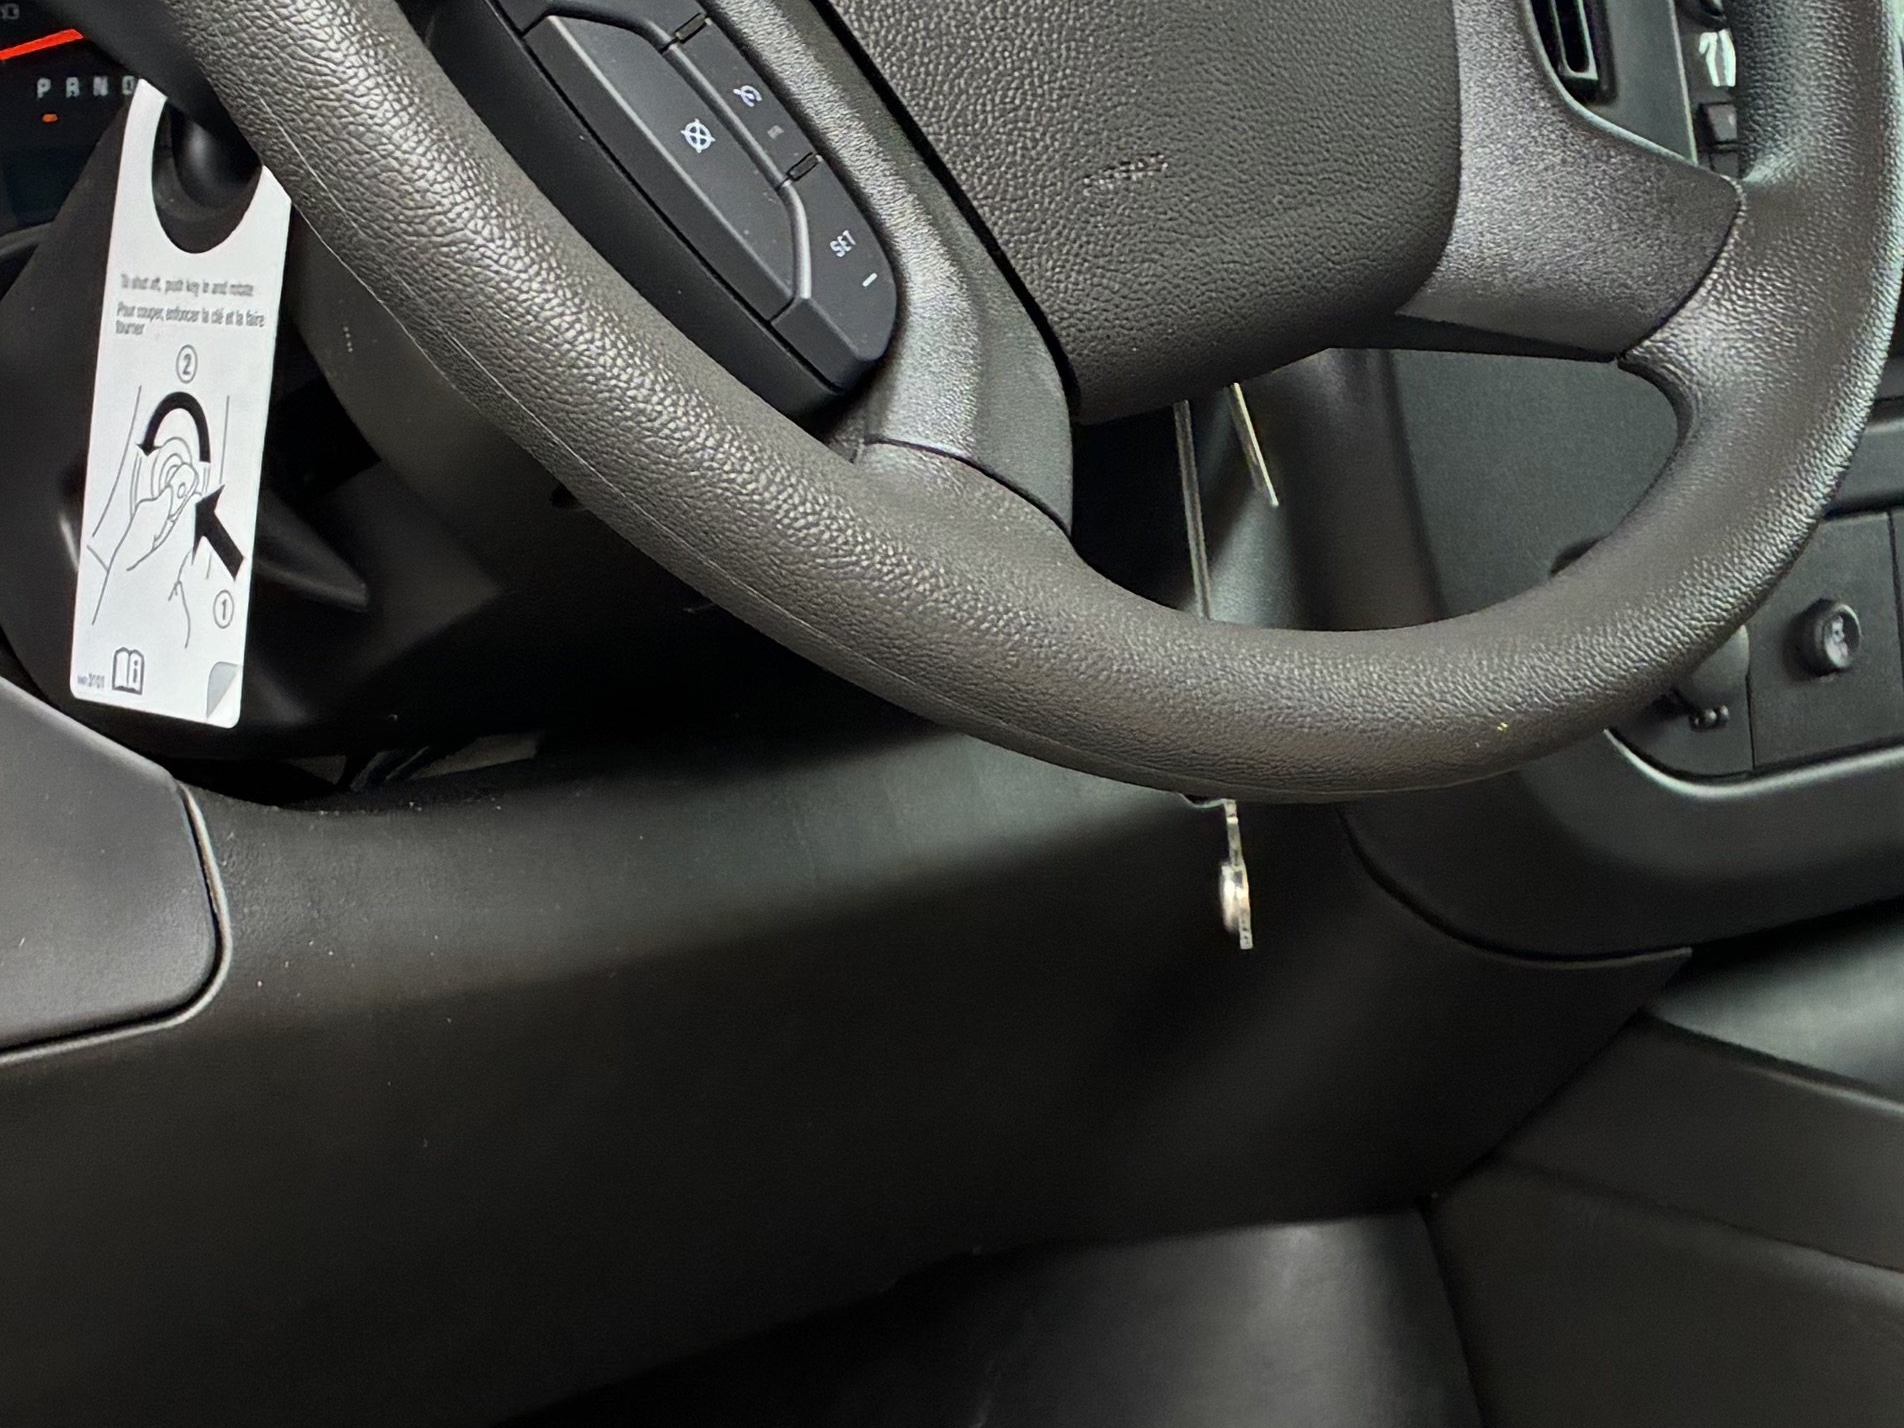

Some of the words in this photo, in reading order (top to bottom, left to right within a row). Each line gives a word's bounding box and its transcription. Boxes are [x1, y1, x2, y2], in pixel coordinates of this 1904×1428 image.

[37, 77, 52, 99] P
[65, 76, 80, 98] R
[92, 75, 108, 97] N
[829, 229, 857, 258] SET
